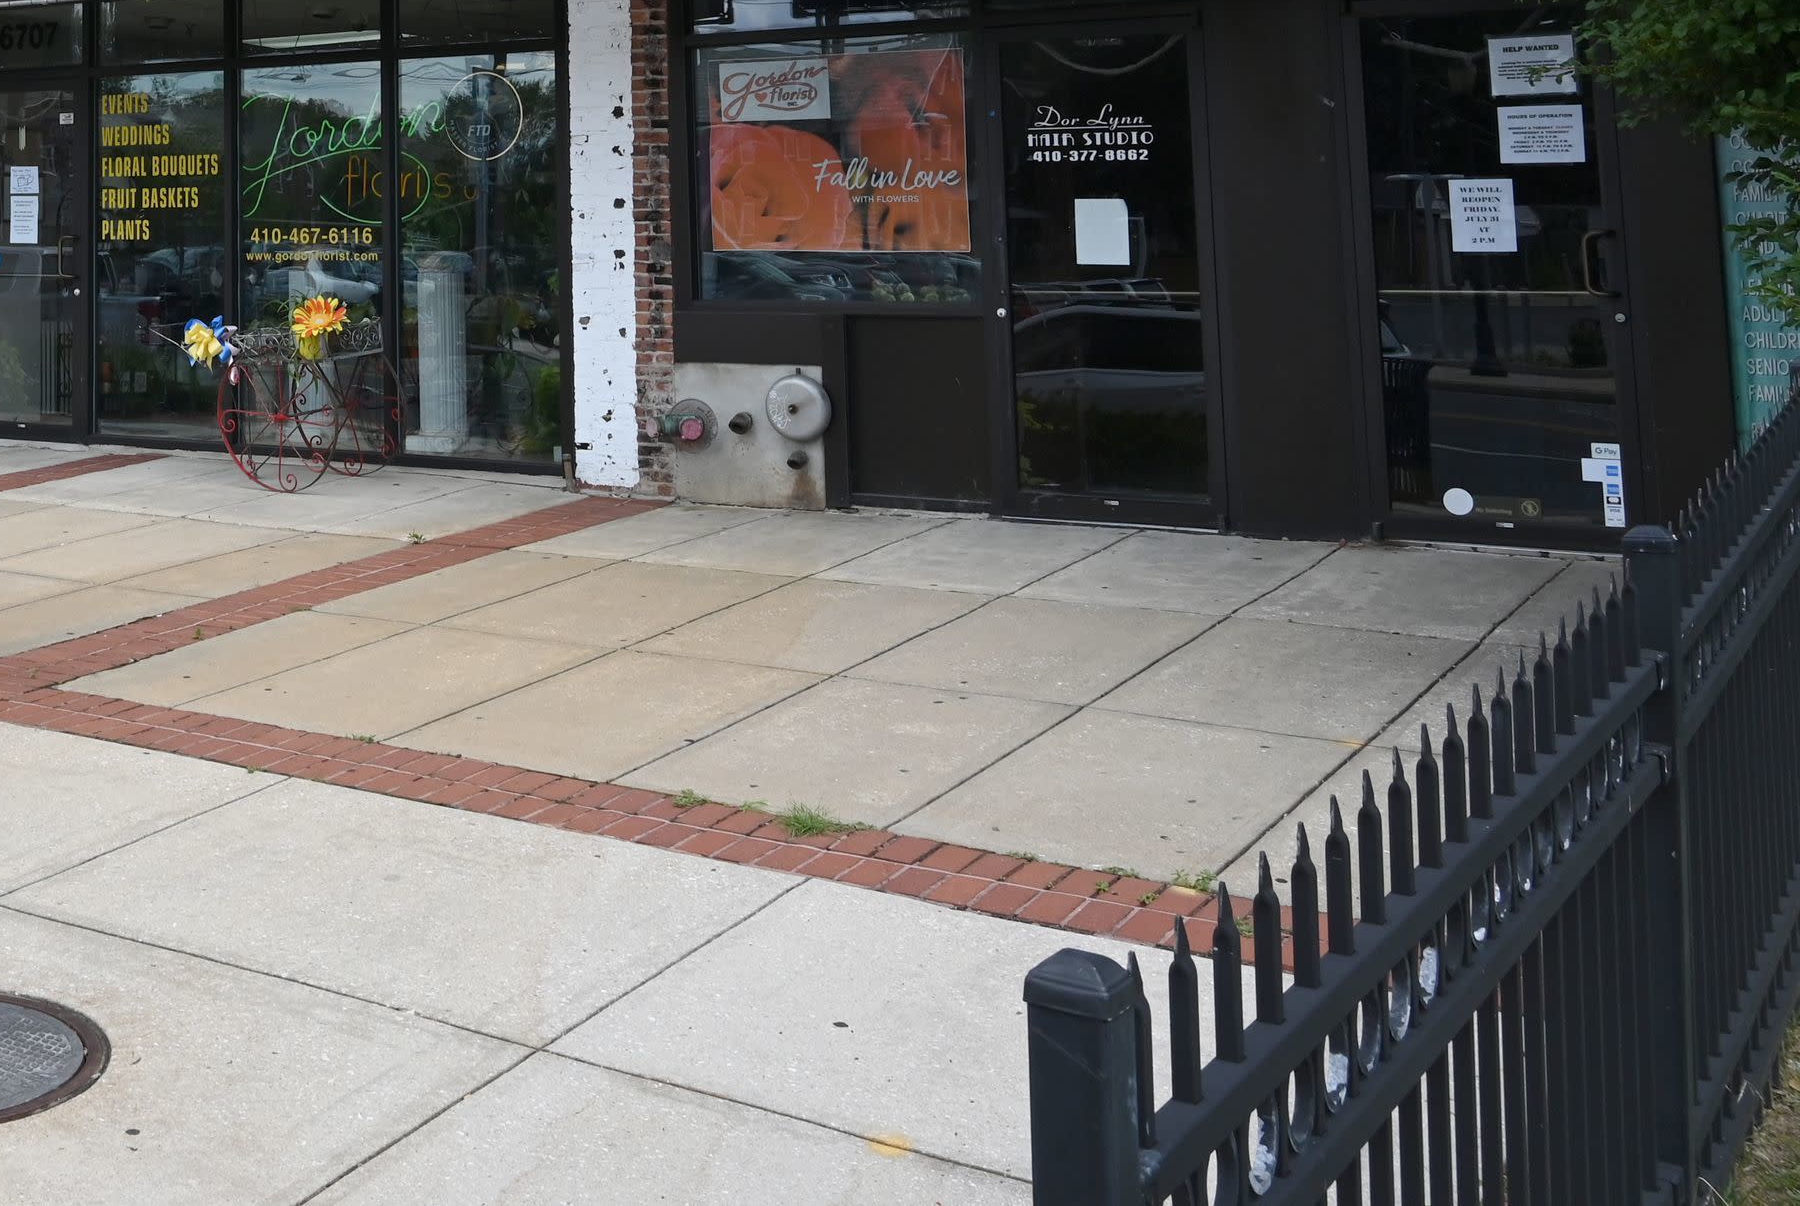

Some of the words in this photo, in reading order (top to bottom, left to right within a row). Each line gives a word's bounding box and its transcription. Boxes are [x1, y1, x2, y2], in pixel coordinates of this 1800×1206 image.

[0, 22, 58, 51] 6707
[1502, 46, 1524, 54] HELP
[1525, 44, 1559, 53] WANTED
[722, 61, 827, 120] gordon
[770, 86, 815, 105] florist
[101, 94, 149, 115] EVENTS
[1034, 105, 1080, 127] Dor
[1086, 103, 1145, 131] Lynn
[101, 124, 170, 147] WEDDINGS
[467, 124, 490, 137] FTD
[1027, 132, 1075, 147] HAIR
[1082, 131, 1154, 146] STUDIO
[101, 156, 147, 178] FLORAL
[152, 153, 219, 176] BOUQUETS
[1033, 149, 1149, 162] 410-377-8662
[812, 156, 868, 193] Fall
[871, 167, 896, 190] in
[900, 157, 962, 191] Love
[101, 188, 136, 209] FRUIT
[142, 187, 199, 208] BASKETS
[852, 195, 874, 203] WITH
[876, 194, 919, 203] FLOWERS
[101, 219, 150, 241] PLANTS
[250, 227, 373, 244] 410-467-6116
